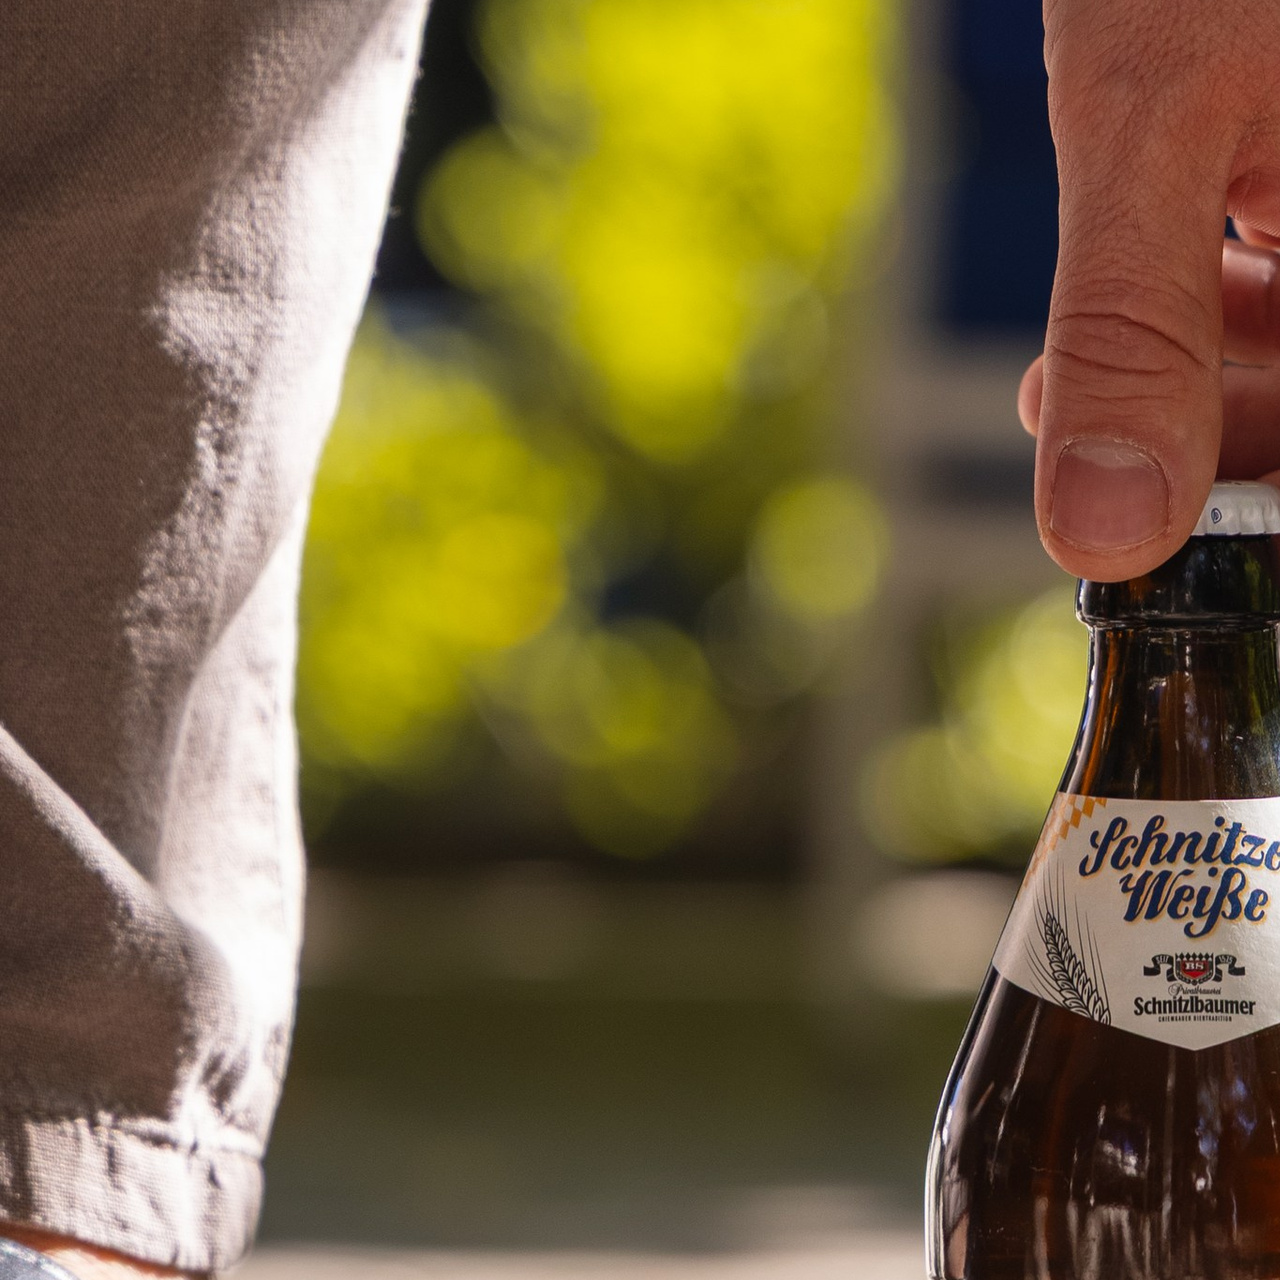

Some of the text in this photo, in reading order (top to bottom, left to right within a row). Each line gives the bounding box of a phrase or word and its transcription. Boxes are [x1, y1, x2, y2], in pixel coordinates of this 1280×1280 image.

[1119, 866, 1270, 938] Weiße
[1184, 961, 1205, 971] BS
[1133, 995, 1256, 1016] Schnitzlbaumer
